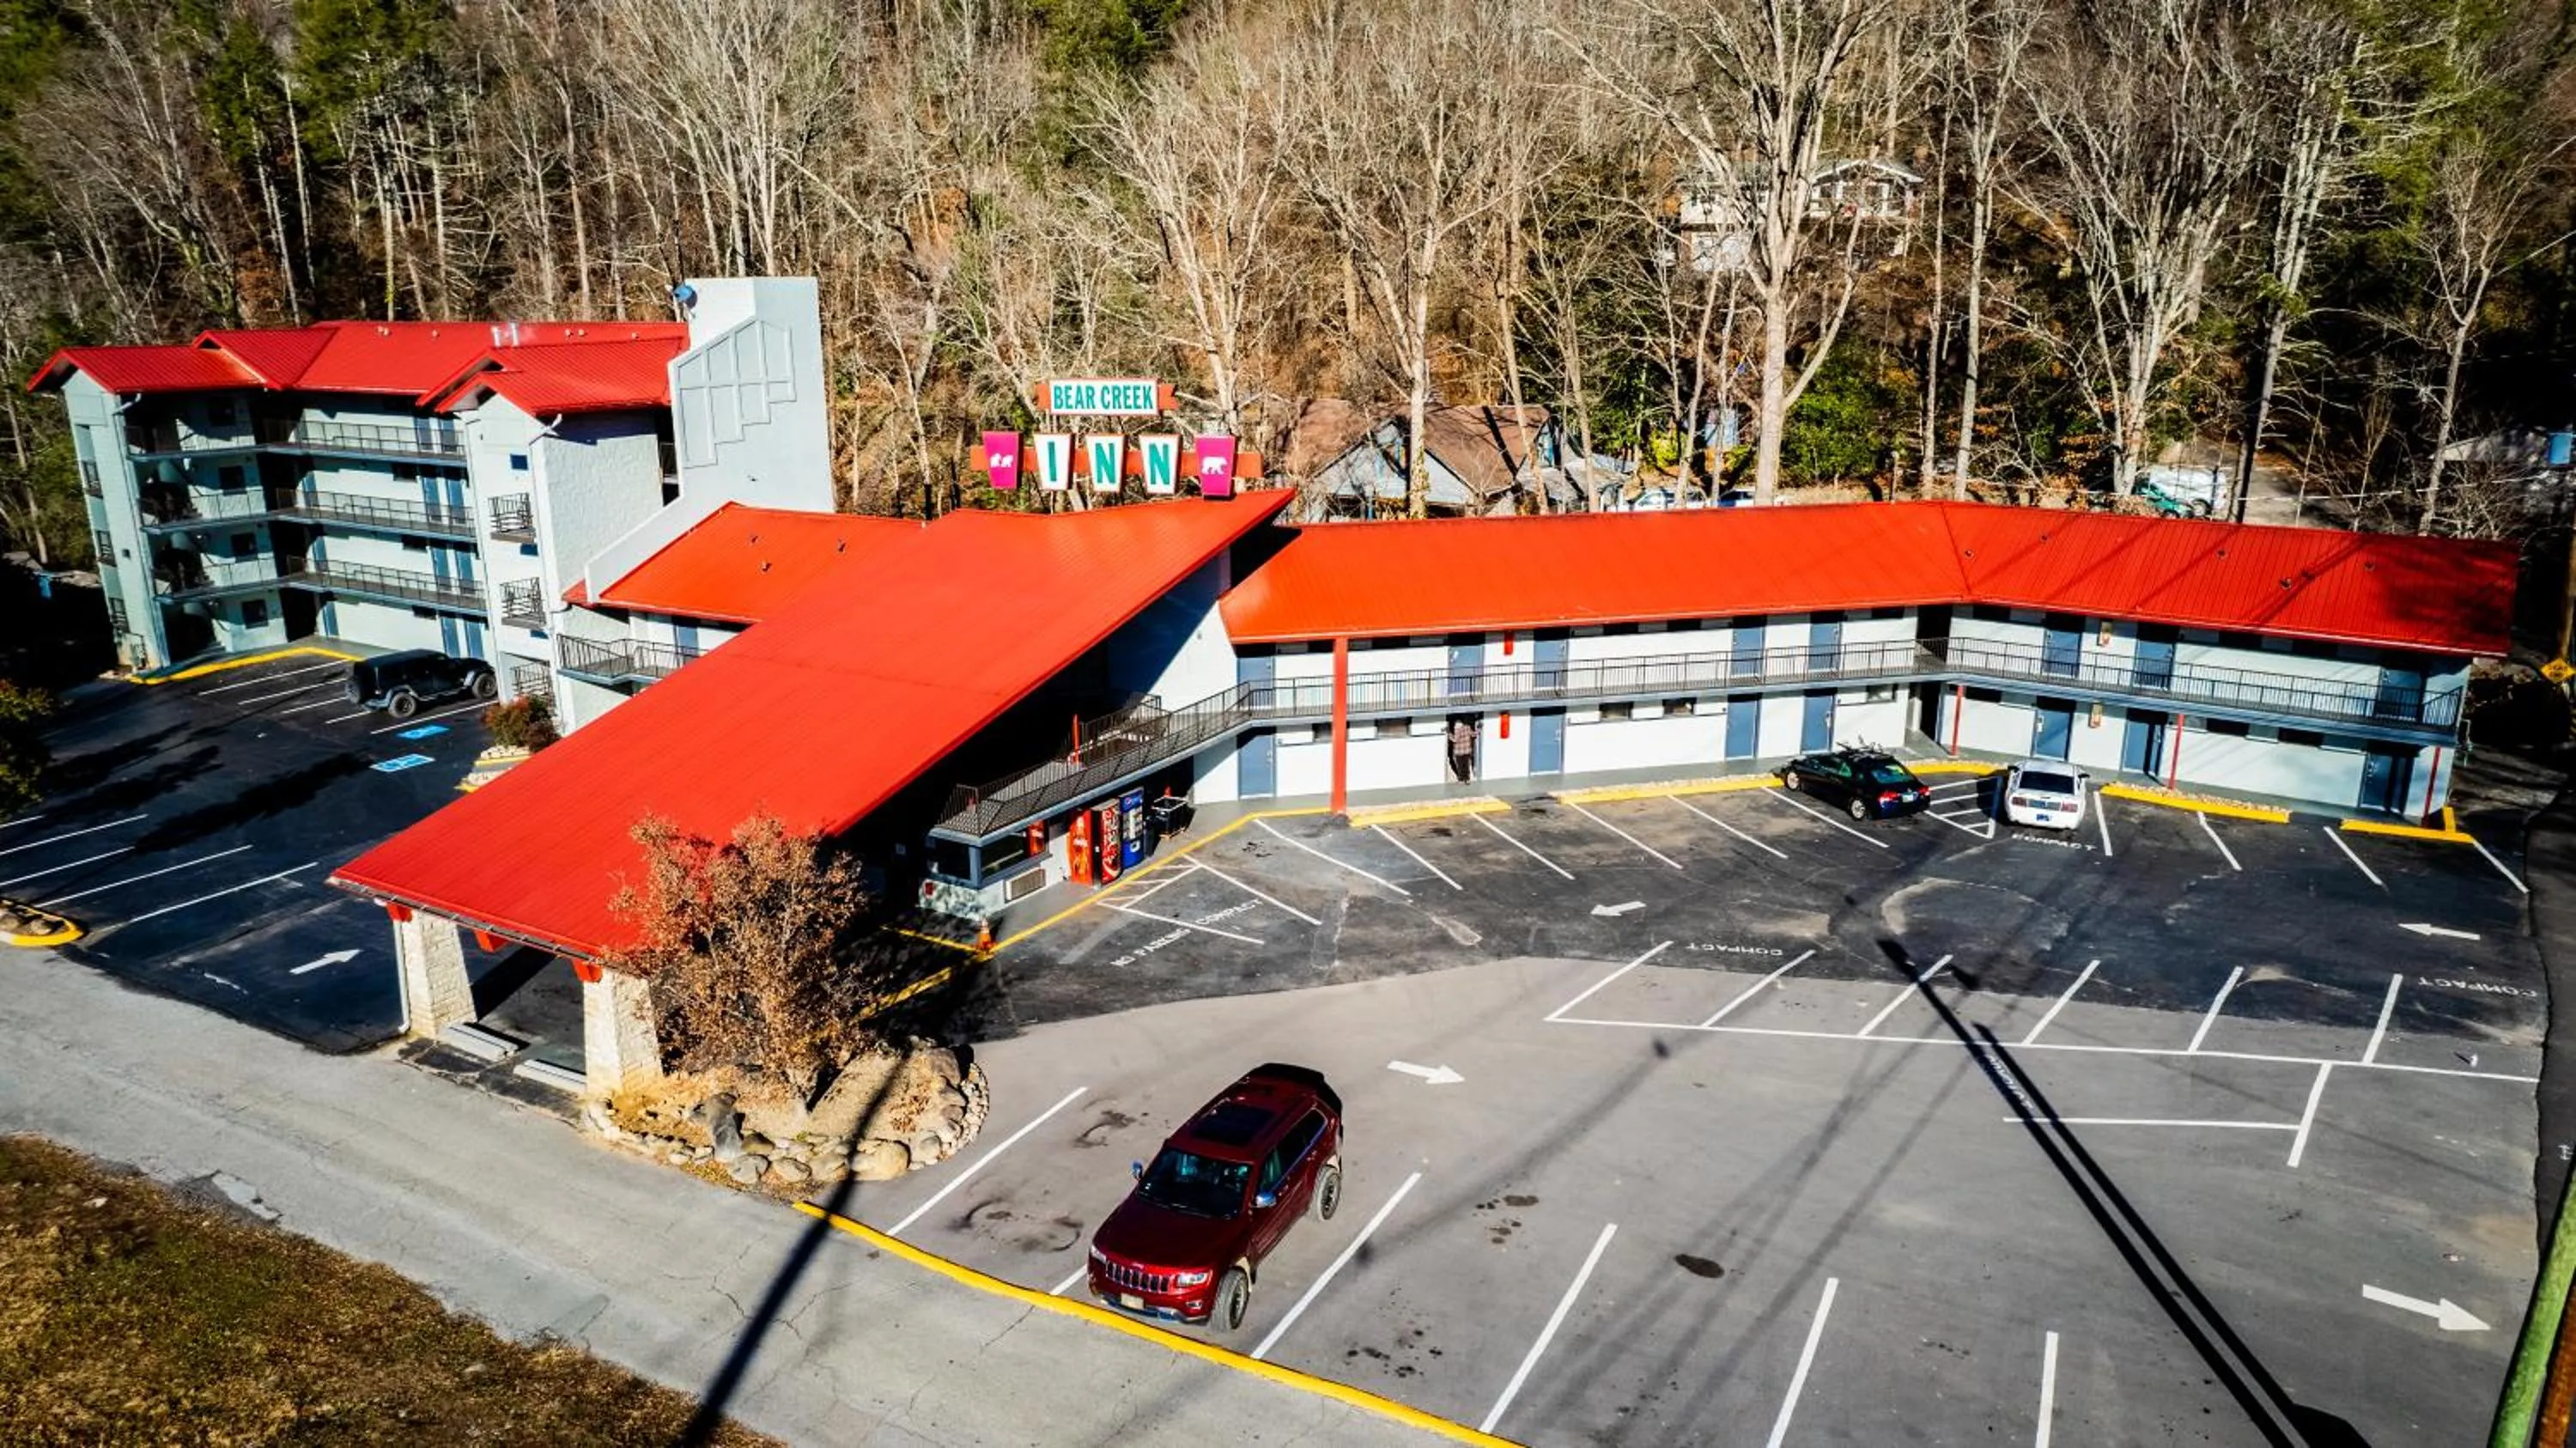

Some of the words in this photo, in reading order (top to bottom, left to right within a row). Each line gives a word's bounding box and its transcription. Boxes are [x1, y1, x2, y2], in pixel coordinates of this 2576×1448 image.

[1054, 385, 1096, 410] BEAR
[1100, 385, 1153, 410] CREEK
[1048, 441, 1170, 485] INN
[1686, 942, 1783, 957] COMPACT
[2418, 976, 2538, 998] COMPACT
